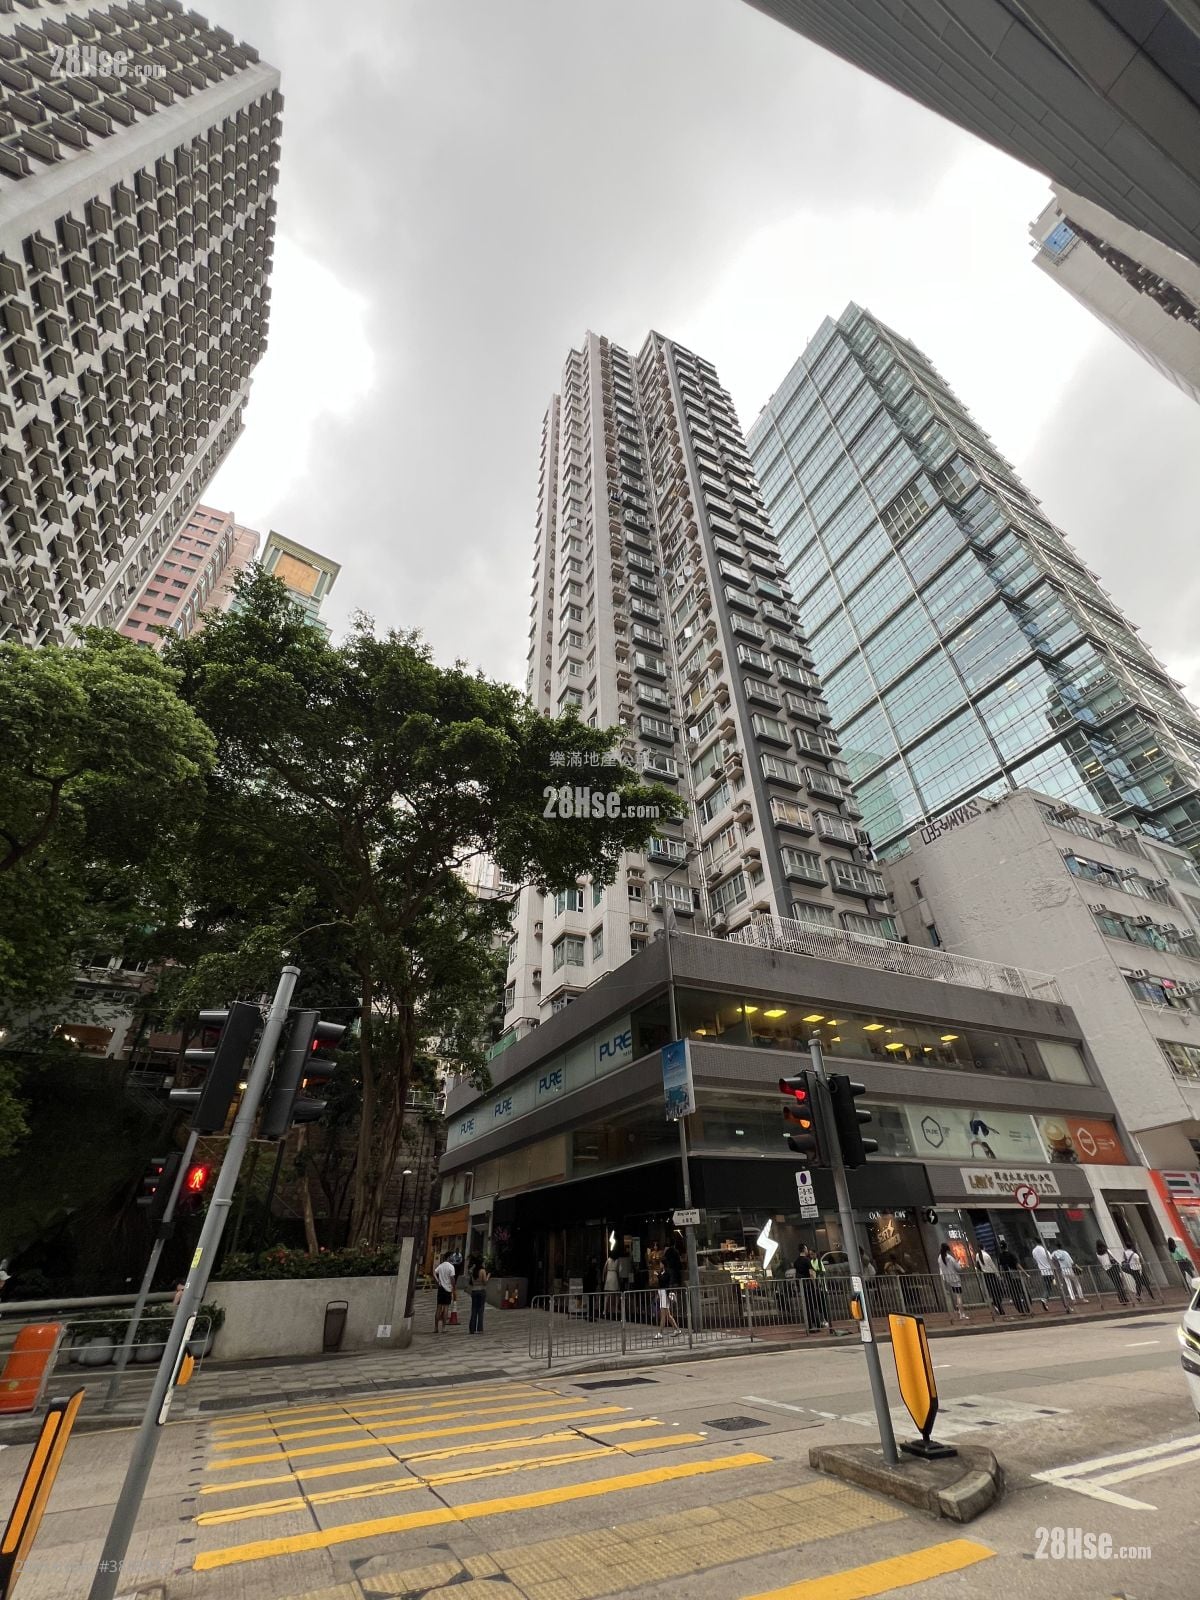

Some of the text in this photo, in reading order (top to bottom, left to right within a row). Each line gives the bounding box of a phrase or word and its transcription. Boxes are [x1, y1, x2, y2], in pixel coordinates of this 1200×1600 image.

[599, 1029, 632, 1062] PURE
[538, 1068, 563, 1094] PURE
[494, 1096, 513, 1118] PURE
[460, 1118, 475, 1136] PURE
